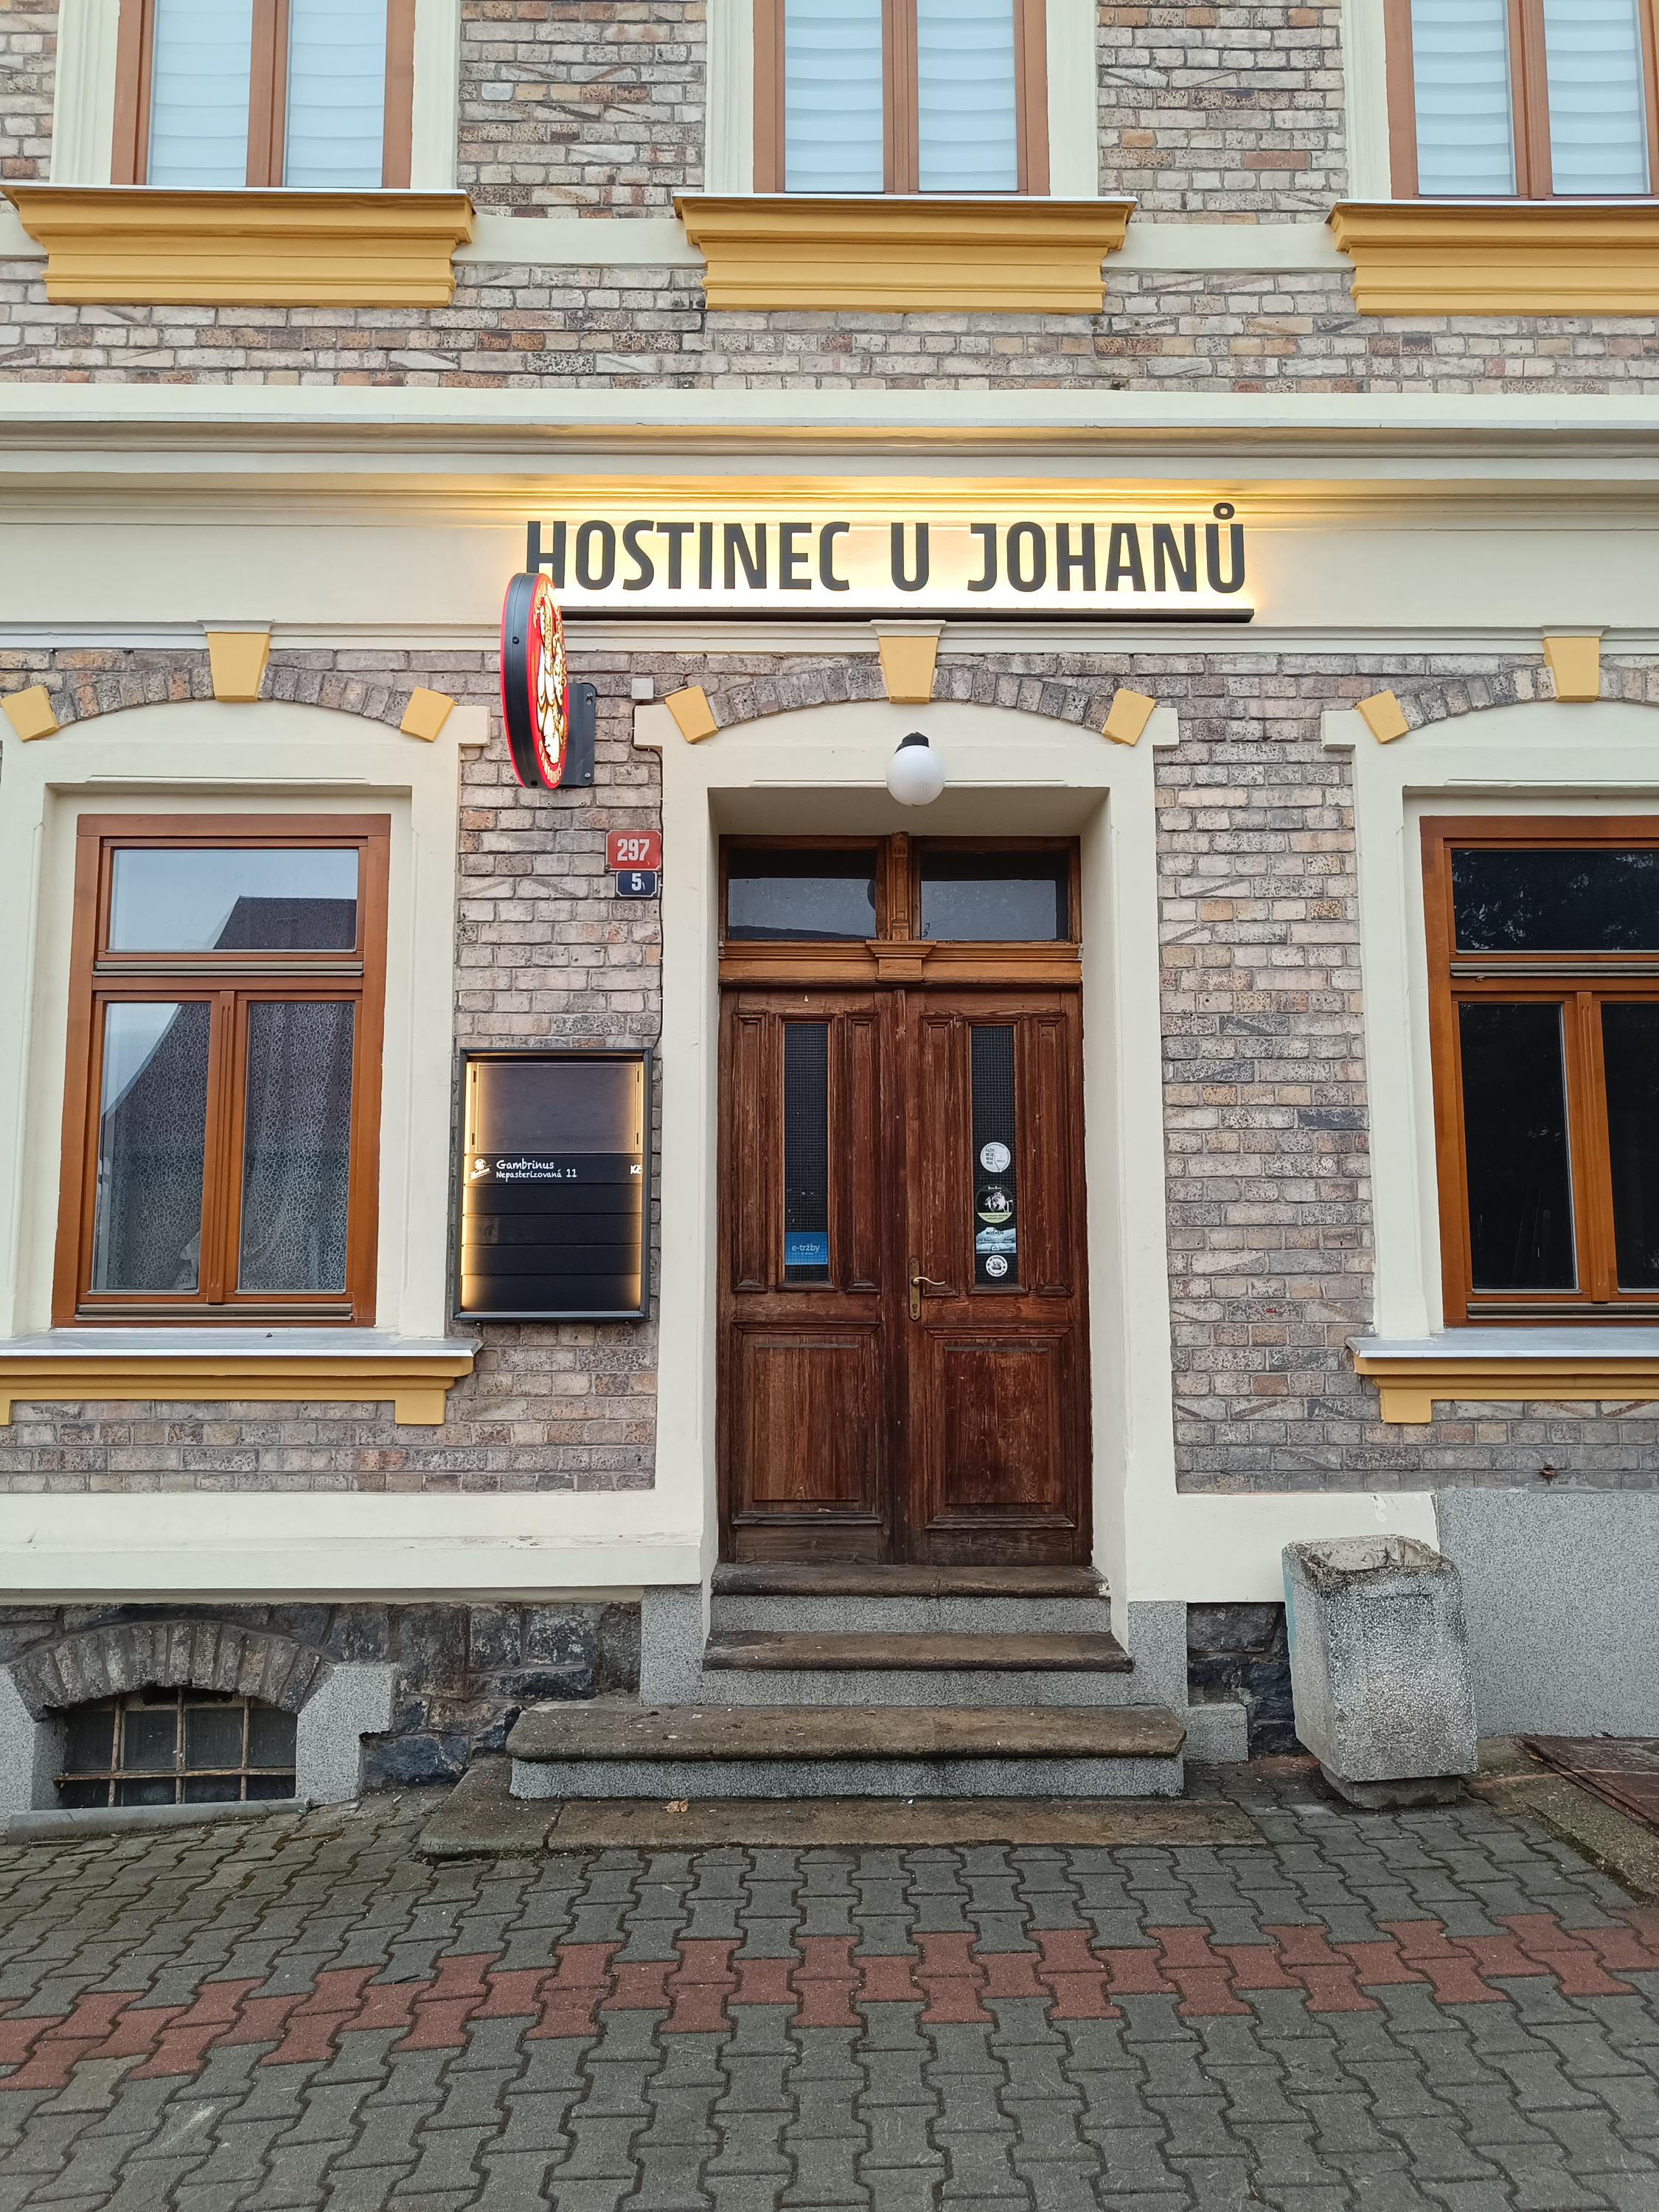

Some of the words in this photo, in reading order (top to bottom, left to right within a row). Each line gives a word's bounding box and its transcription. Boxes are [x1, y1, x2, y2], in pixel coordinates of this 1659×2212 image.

[526, 519, 851, 591] HOSTINEC
[891, 522, 930, 591] U
[967, 502, 1245, 594] JOHANŮ
[616, 838, 650, 862] 297
[631, 872, 642, 891] 5
[495, 1158, 554, 1170] Gambrinus
[495, 1169, 563, 1183] Nepasterizovaná
[566, 1169, 577, 1178] 11
[791, 1242, 821, 1253] e-tržby
